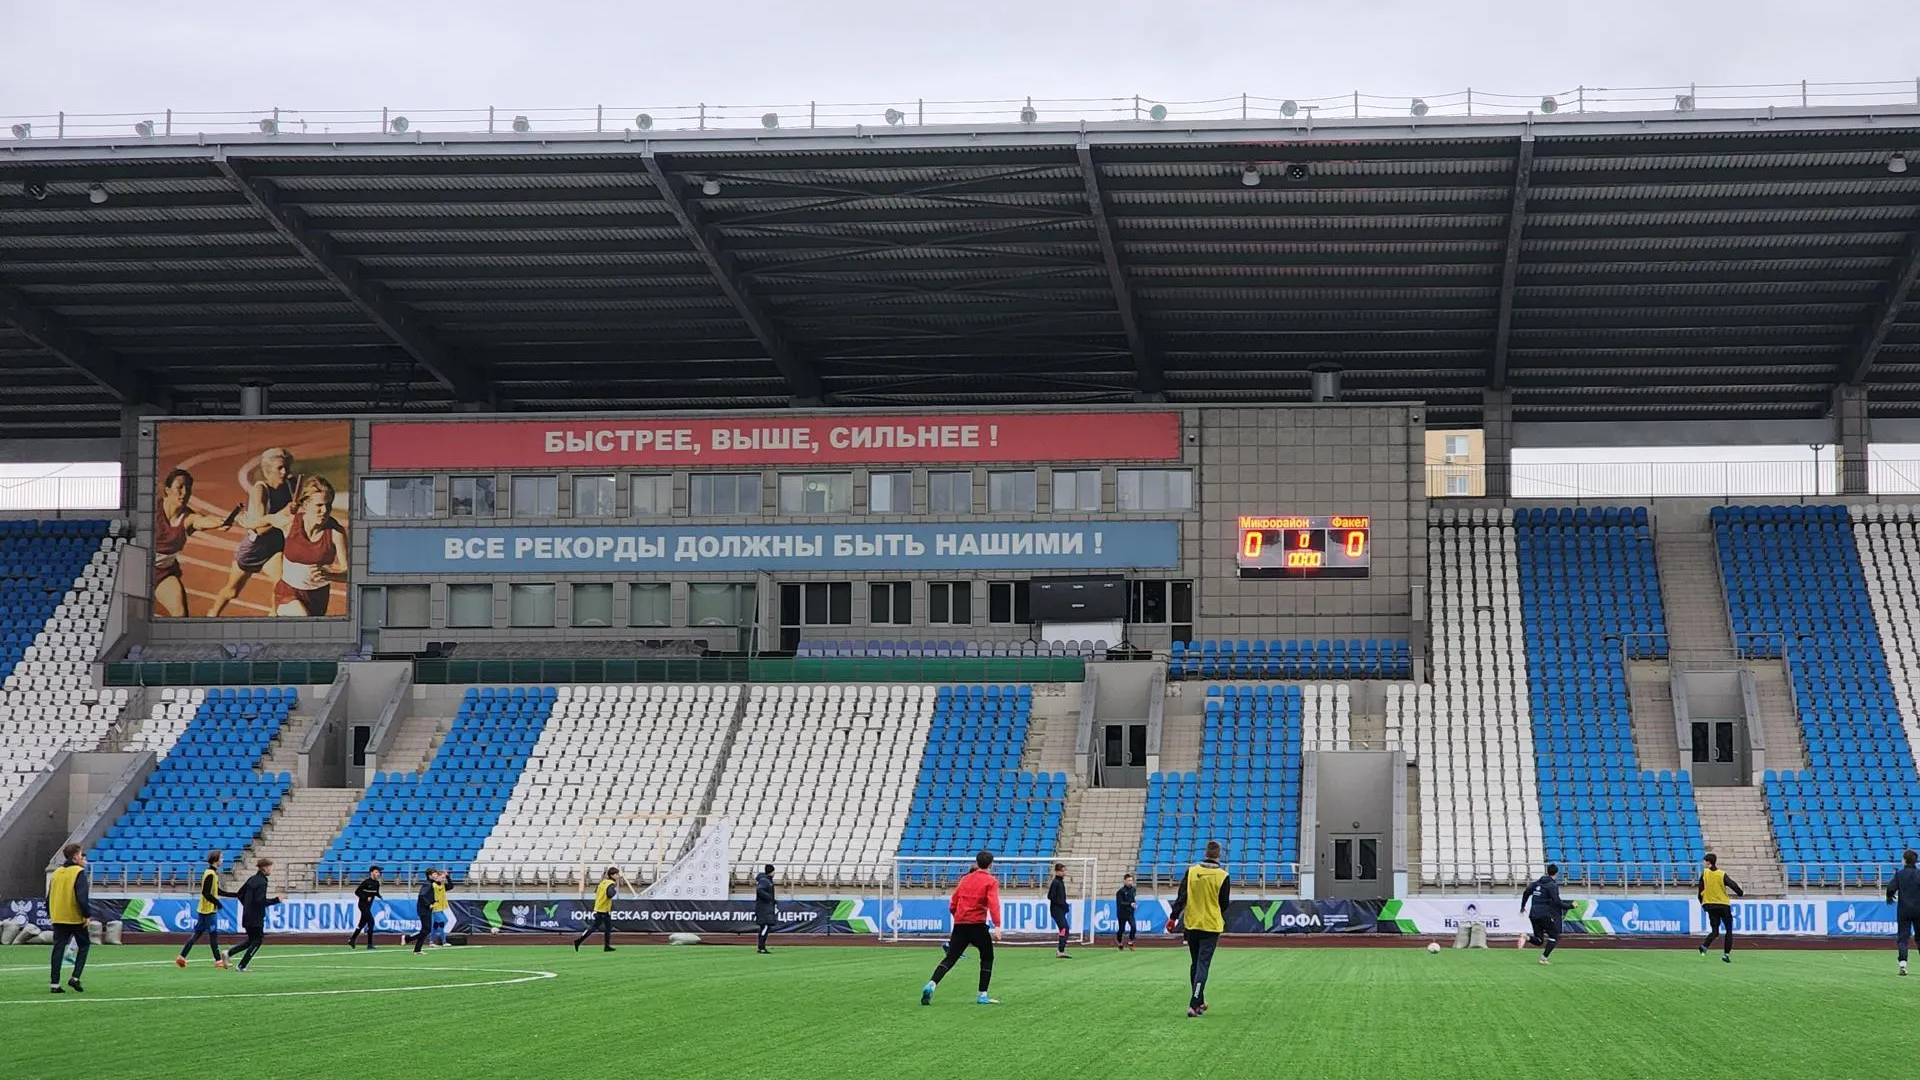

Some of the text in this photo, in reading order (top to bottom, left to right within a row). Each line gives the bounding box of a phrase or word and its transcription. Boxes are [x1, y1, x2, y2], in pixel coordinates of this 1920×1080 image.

[545, 429, 701, 455] БЫСТРЕЕ,
[711, 427, 819, 453] ВЫШЕ,
[829, 425, 979, 449] СИЛЬНЕЕ
[1241, 516, 1368, 529] Микрорайон Факел
[444, 537, 505, 559] ВСЕ
[515, 536, 665, 562] РЕКОРДЫ
[674, 535, 823, 562] ДОЛЖНЫ
[833, 534, 925, 557] БЫТЬ
[935, 532, 1083, 556] НАШИМИ
[1244, 531, 1262, 557] 0
[1299, 533, 1310, 548] 0
[1347, 531, 1364, 557] 0
[651, 911, 730, 922] ФУТБОЛЬНАЯ
[777, 911, 818, 923] ЦЕНТР
[1639, 920, 1680, 931] ГАЗПРОМ
